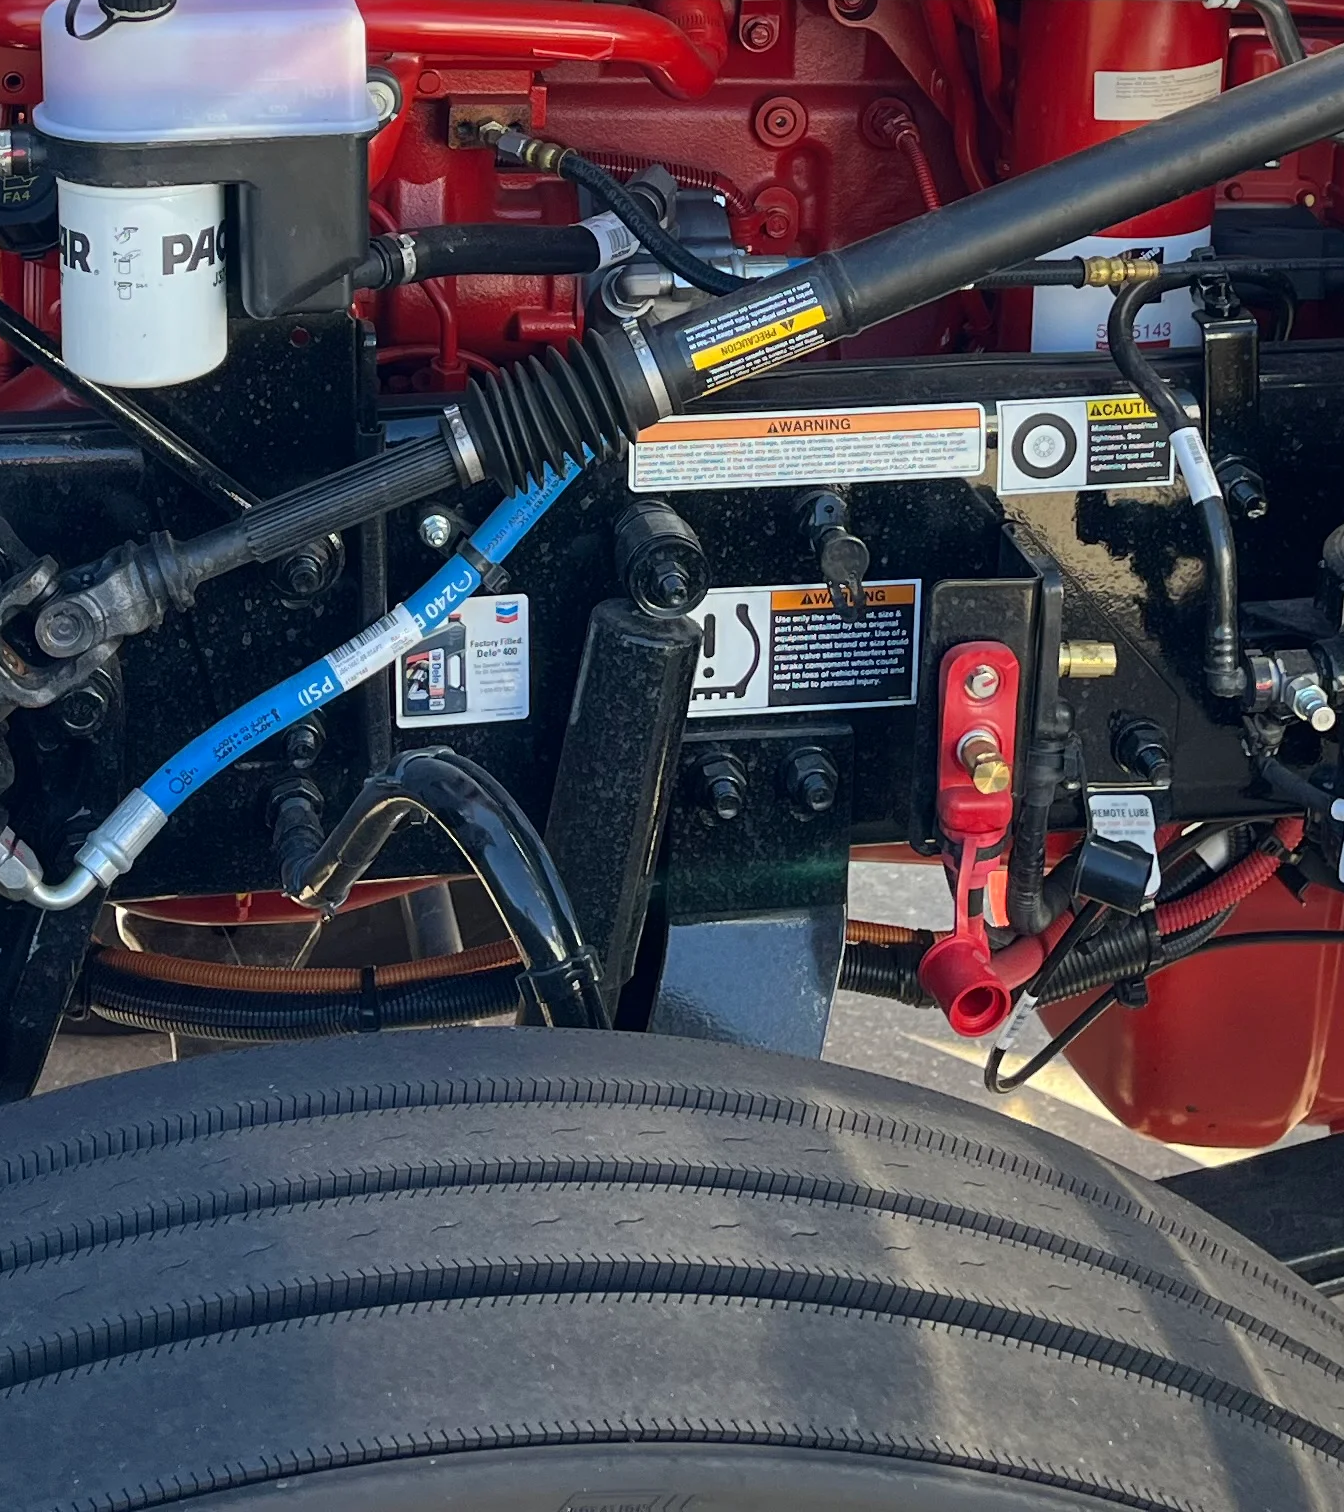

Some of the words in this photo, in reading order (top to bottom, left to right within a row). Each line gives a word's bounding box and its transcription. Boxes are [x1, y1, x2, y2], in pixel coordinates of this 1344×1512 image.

[2, 189, 32, 204] FA4
[1102, 402, 1154, 416] CAUTI
[778, 418, 851, 434] WARNING
[425, 585, 458, 619] 240
[470, 638, 498, 649] Factory
[502, 647, 518, 656] 400
[431, 662, 442, 684] Delo
[1091, 808, 1127, 818] REMOTE
[1129, 808, 1150, 817] LUBE
